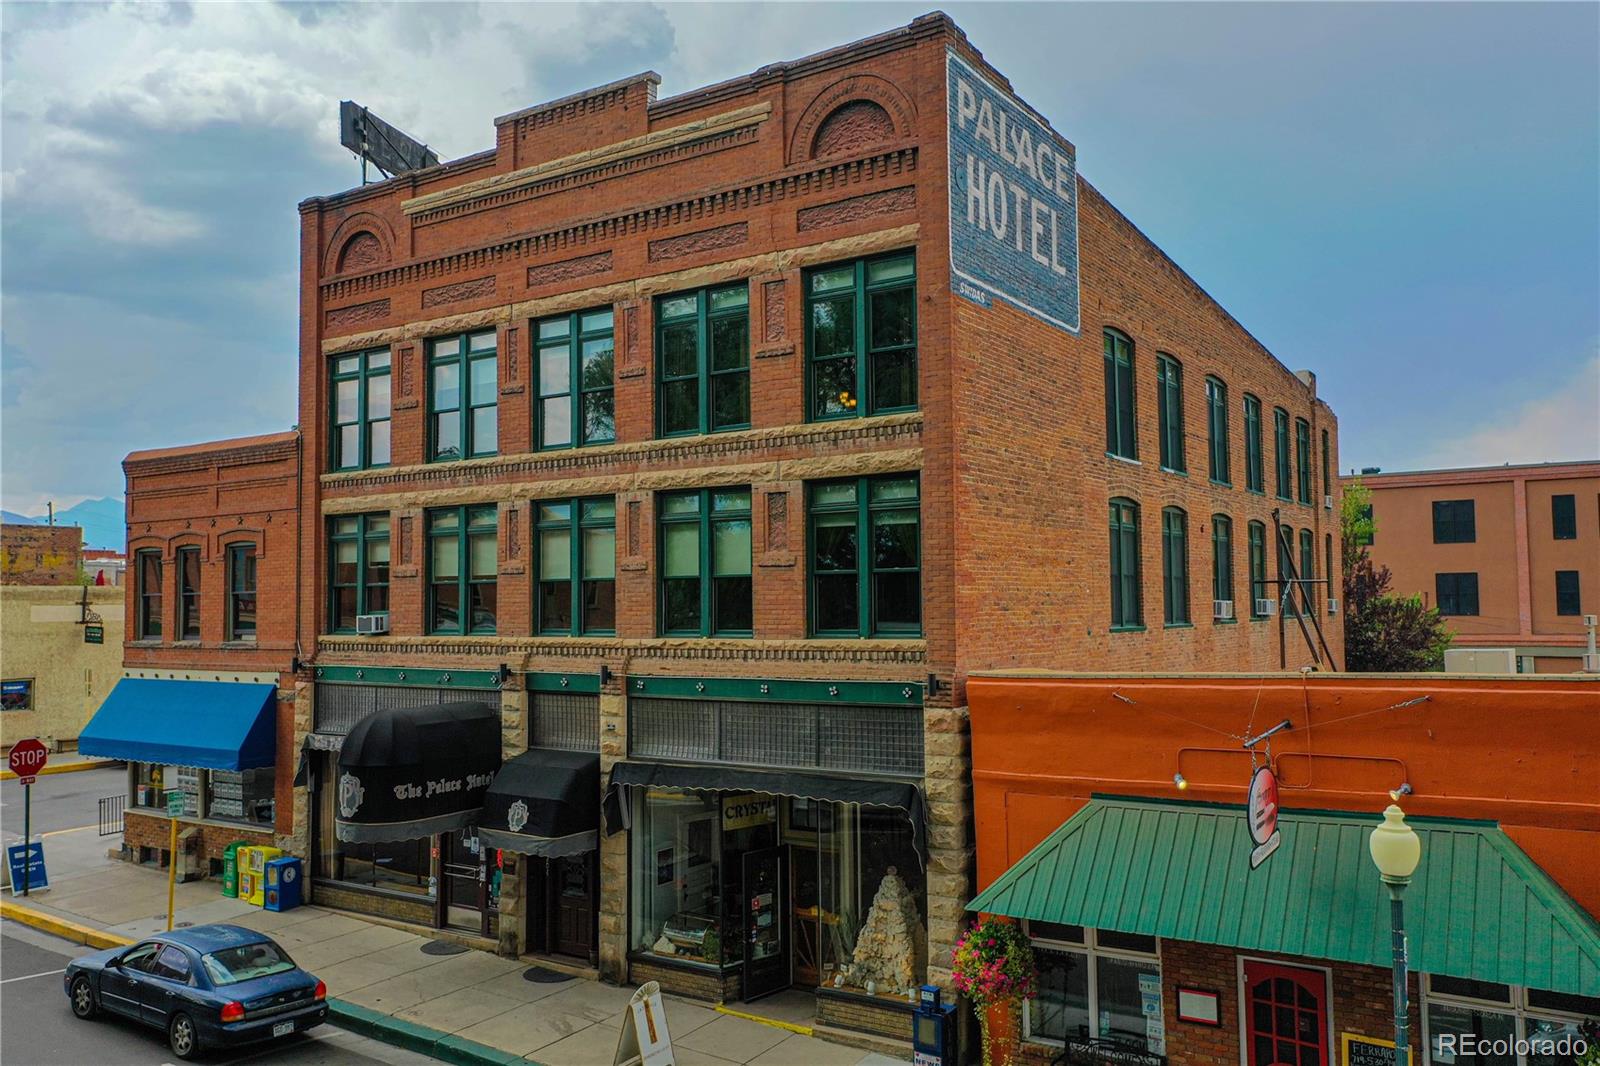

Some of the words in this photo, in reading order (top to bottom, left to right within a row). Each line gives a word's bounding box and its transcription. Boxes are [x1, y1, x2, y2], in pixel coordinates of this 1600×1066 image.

[957, 77, 1069, 200] PALACE
[966, 153, 1067, 275] HOTEL
[11, 749, 45, 767] STOP
[393, 783, 423, 800] The
